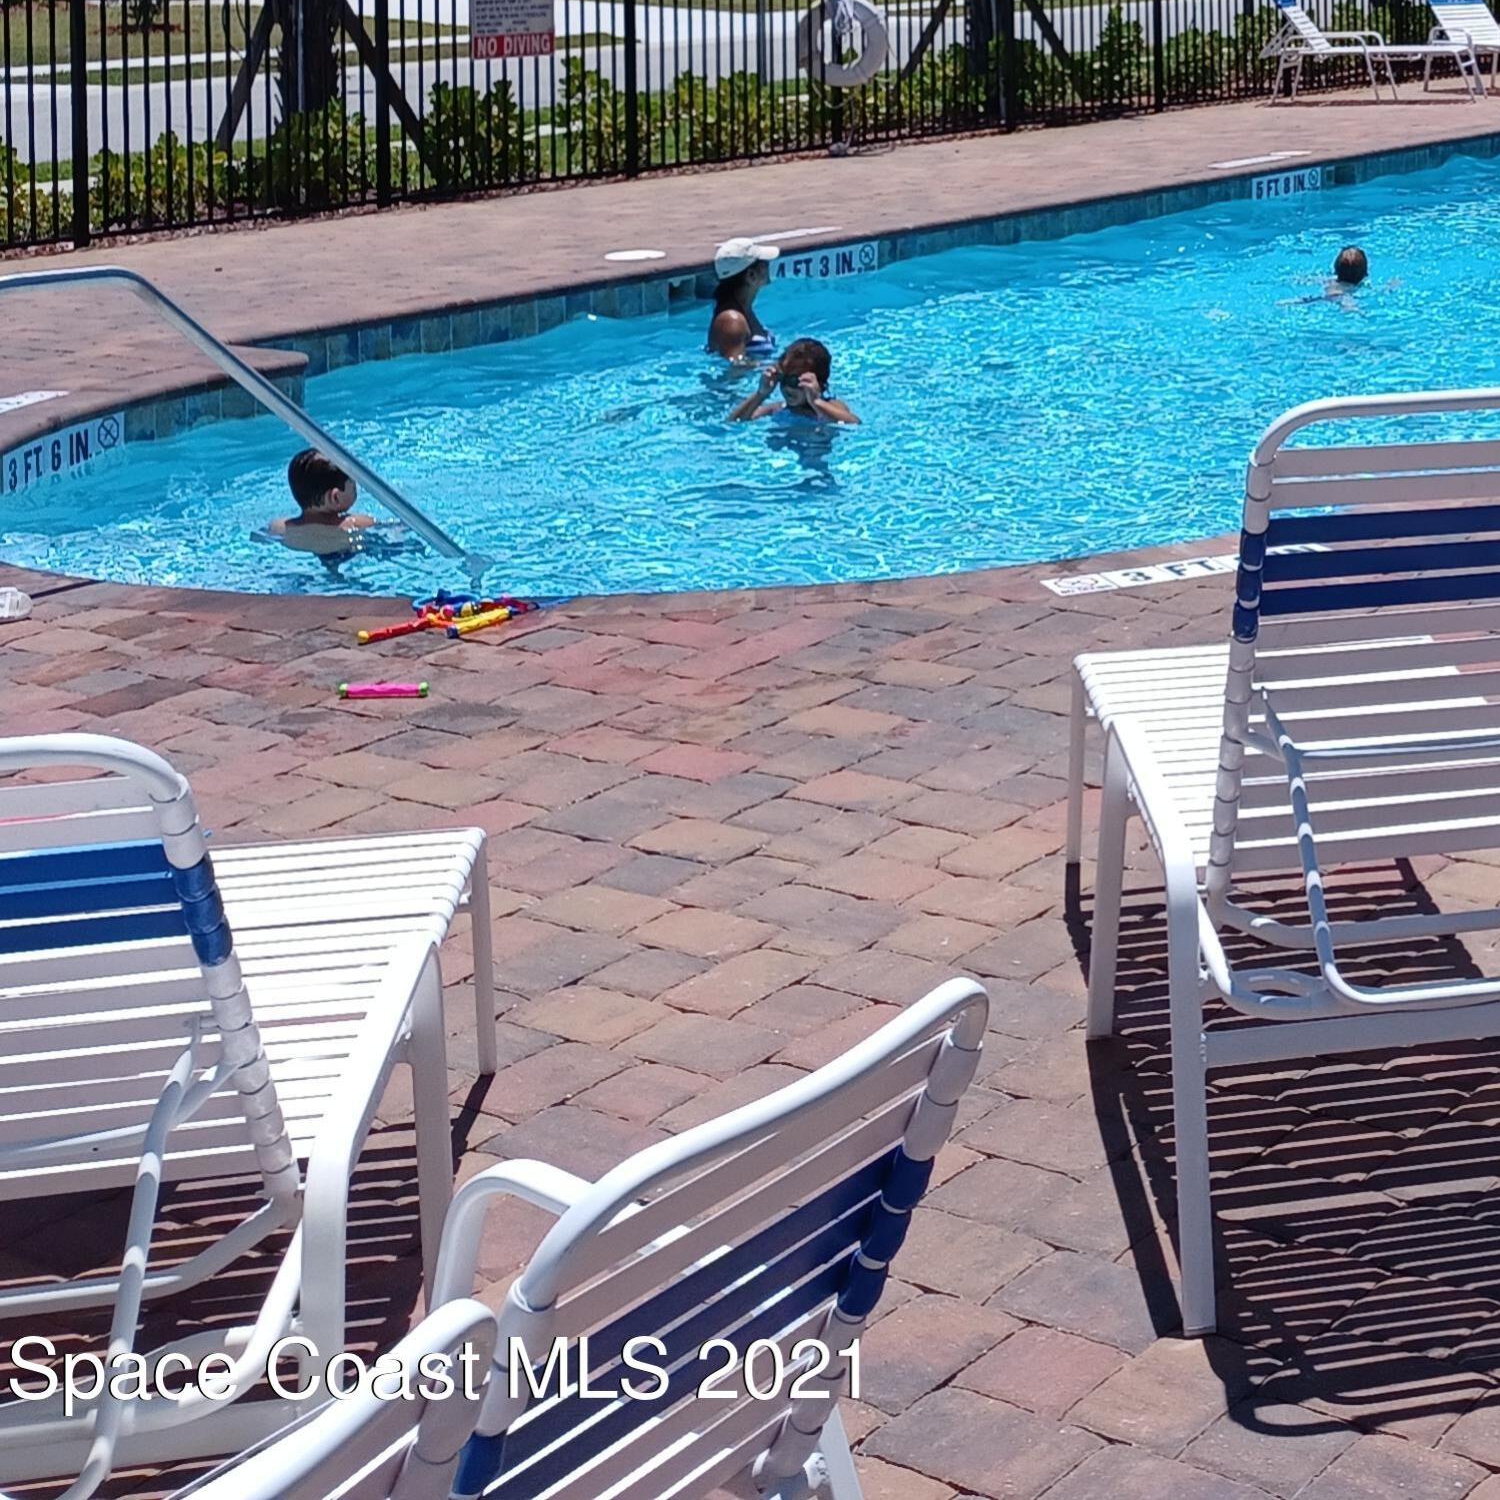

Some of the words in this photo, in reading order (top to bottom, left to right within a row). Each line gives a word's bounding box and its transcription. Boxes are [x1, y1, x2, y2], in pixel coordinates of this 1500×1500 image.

[477, 36, 498, 57] NO
[503, 33, 551, 55] DIVING
[1256, 181, 1264, 199] 5
[1283, 177, 1290, 194] 8
[820, 255, 830, 277] 3
[9, 458, 18, 491] 3
[51, 440, 61, 471] 6
[1122, 571, 1153, 582] 3
